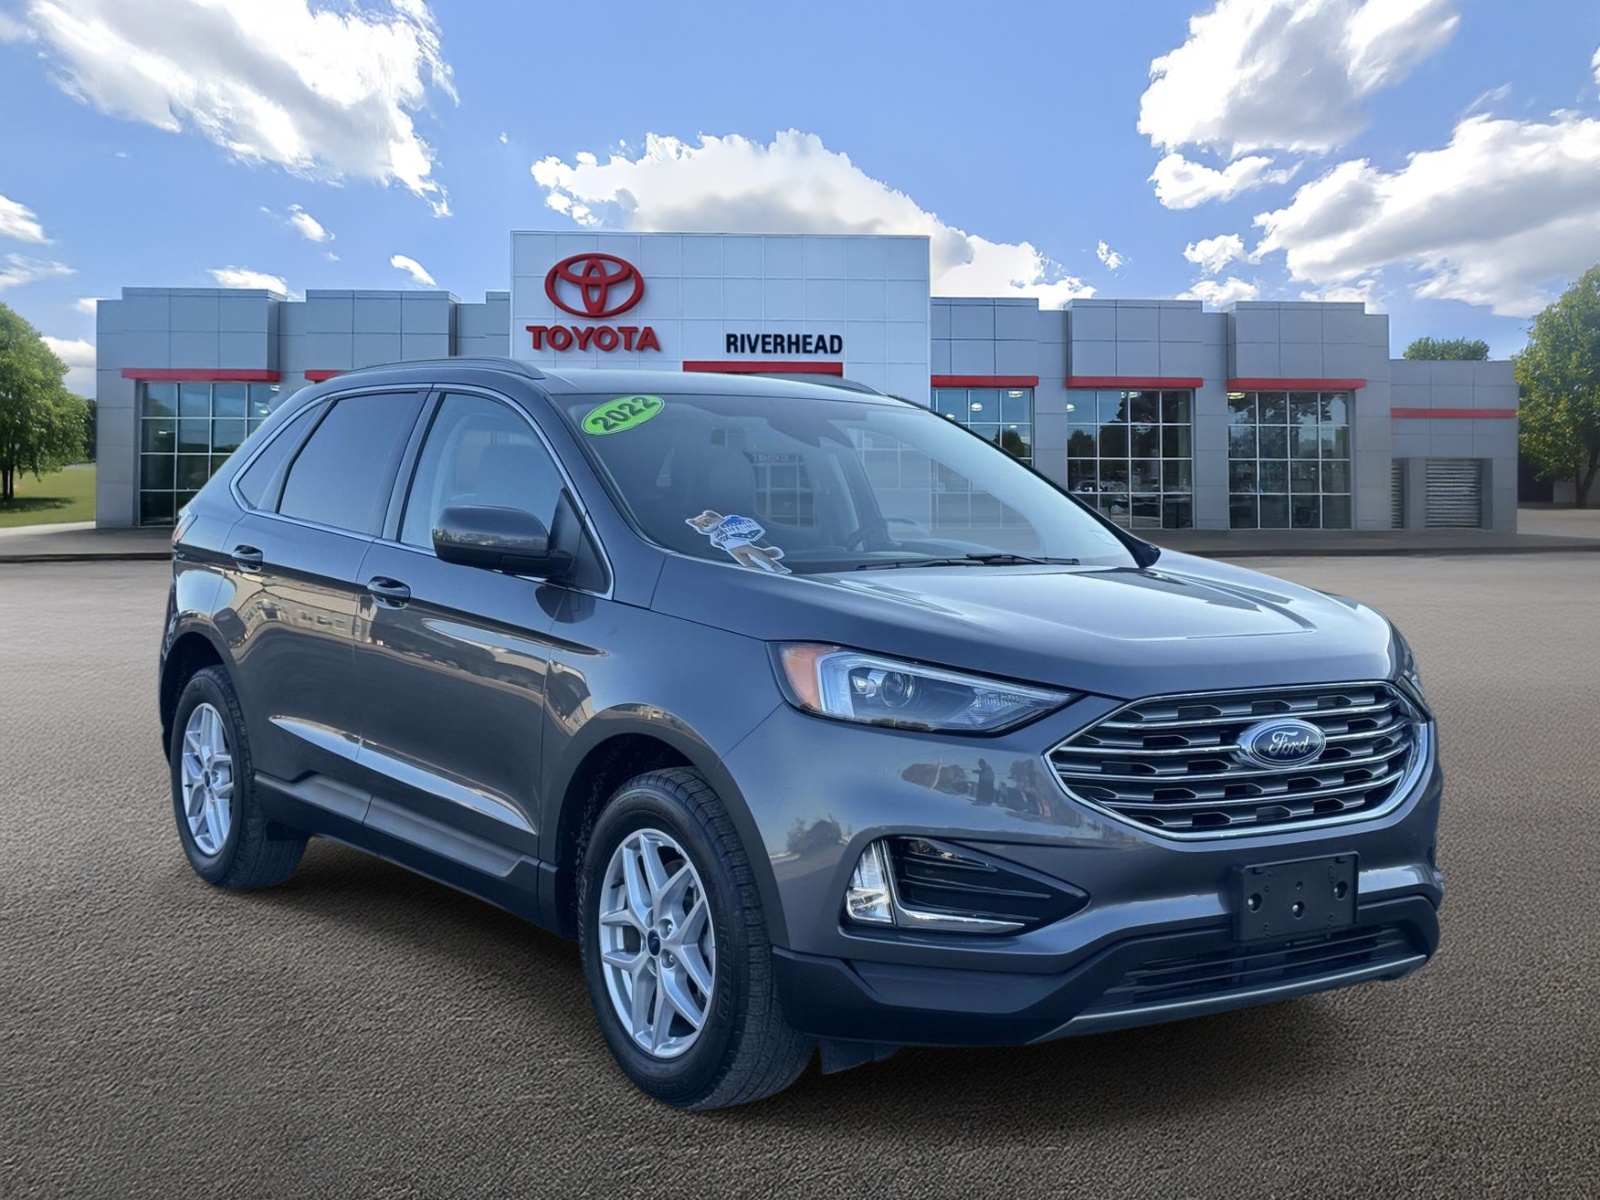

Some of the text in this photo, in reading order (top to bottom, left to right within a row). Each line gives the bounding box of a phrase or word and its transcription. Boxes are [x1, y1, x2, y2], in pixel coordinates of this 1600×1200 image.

[525, 325, 662, 352] TOYOTA
[726, 333, 843, 354] RIVERHEAD
[591, 396, 659, 431] 2022
[1268, 731, 1310, 756] Ford
